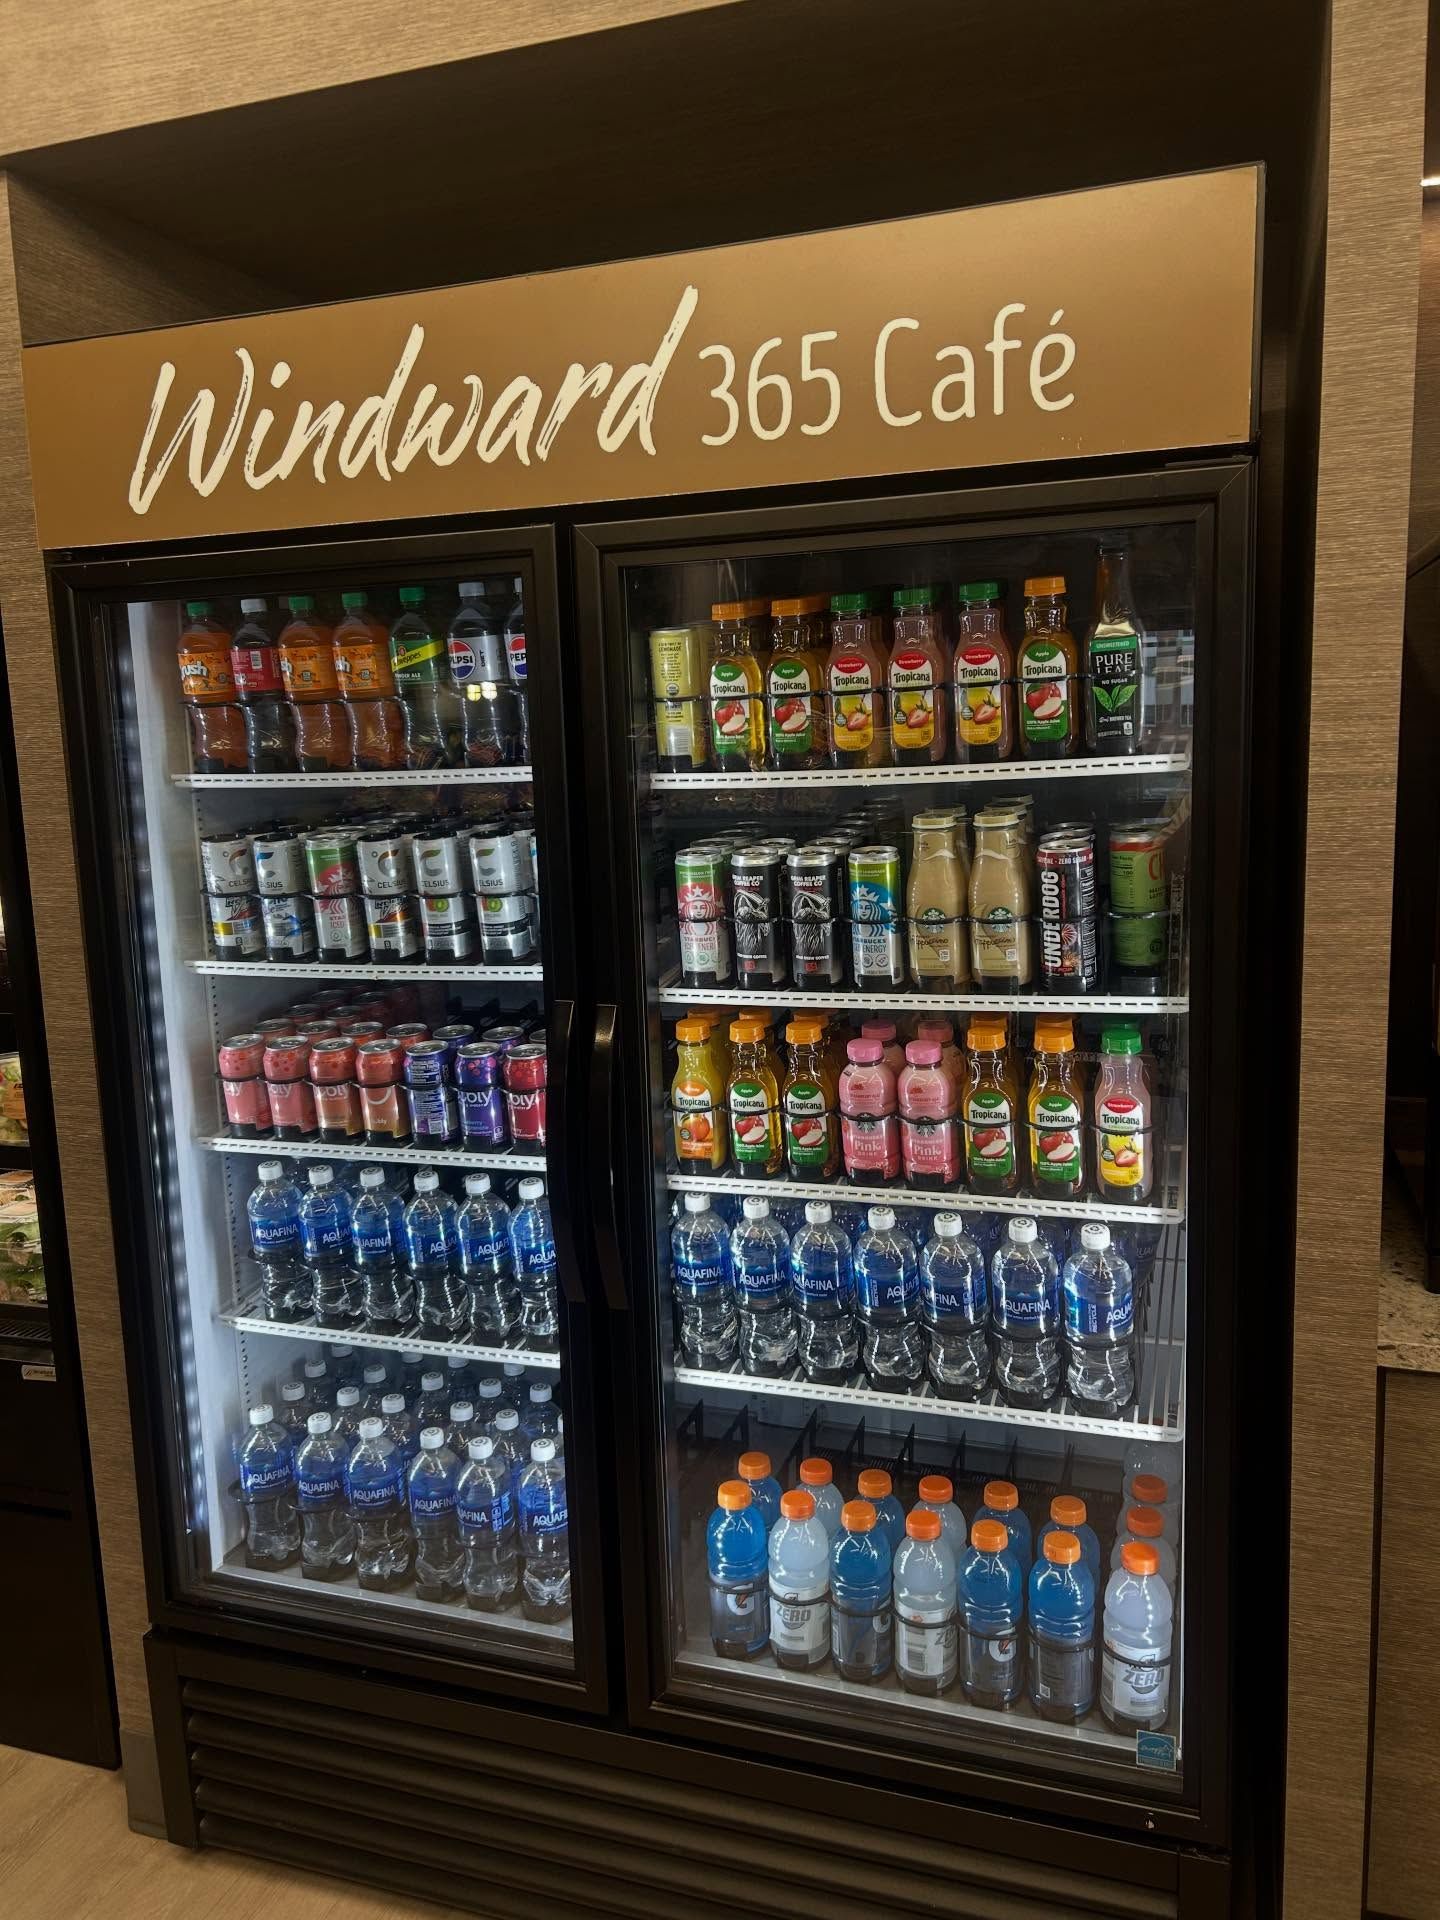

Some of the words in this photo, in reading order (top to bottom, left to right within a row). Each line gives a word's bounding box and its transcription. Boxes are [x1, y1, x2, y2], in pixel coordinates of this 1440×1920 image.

[128, 285, 698, 516] Windward
[699, 329, 842, 447] 365
[874, 302, 1077, 428] Café
[510, 652, 526, 662] PEP
[897, 658, 924, 666] Strawberry
[1095, 652, 1133, 667] PURE
[181, 660, 209, 681] rush
[837, 661, 863, 669] Strawberry
[1024, 664, 1063, 676] Tropicana
[893, 671, 931, 684] Tropicana
[960, 666, 998, 679] Tropicana
[772, 680, 807, 691] Tropicana
[833, 674, 870, 687] Tropicana
[712, 683, 746, 694] Tropicana
[1058, 857, 1072, 865] ZERO
[228, 879, 250, 888] CELSI
[1041, 870, 1062, 968] UNDERDOG
[678, 1097, 710, 1107] Tropicana
[733, 1099, 765, 1108] Tropicana
[788, 1100, 822, 1110] Tropicana
[971, 1109, 1007, 1120] Tropicana
[1037, 1113, 1075, 1123] Tropicana
[1102, 1113, 1140, 1125] Tropicana
[854, 1139, 882, 1152] Pink
[913, 1145, 942, 1156] Pink
[529, 1249, 557, 1265] AQUA
[676, 1265, 722, 1281] AQUAFINA
[739, 1269, 786, 1288] AQUAFINA
[1000, 1299, 1051, 1315] AQUAFINA
[1106, 1299, 1133, 1325] AQUA
[246, 1465, 291, 1486] AQUAFINA
[299, 1479, 340, 1495] AQUAFINA
[353, 1484, 398, 1501] AQUAFINA
[533, 1509, 568, 1527] AQUAFI
[1122, 1667, 1165, 1686] ZERO
